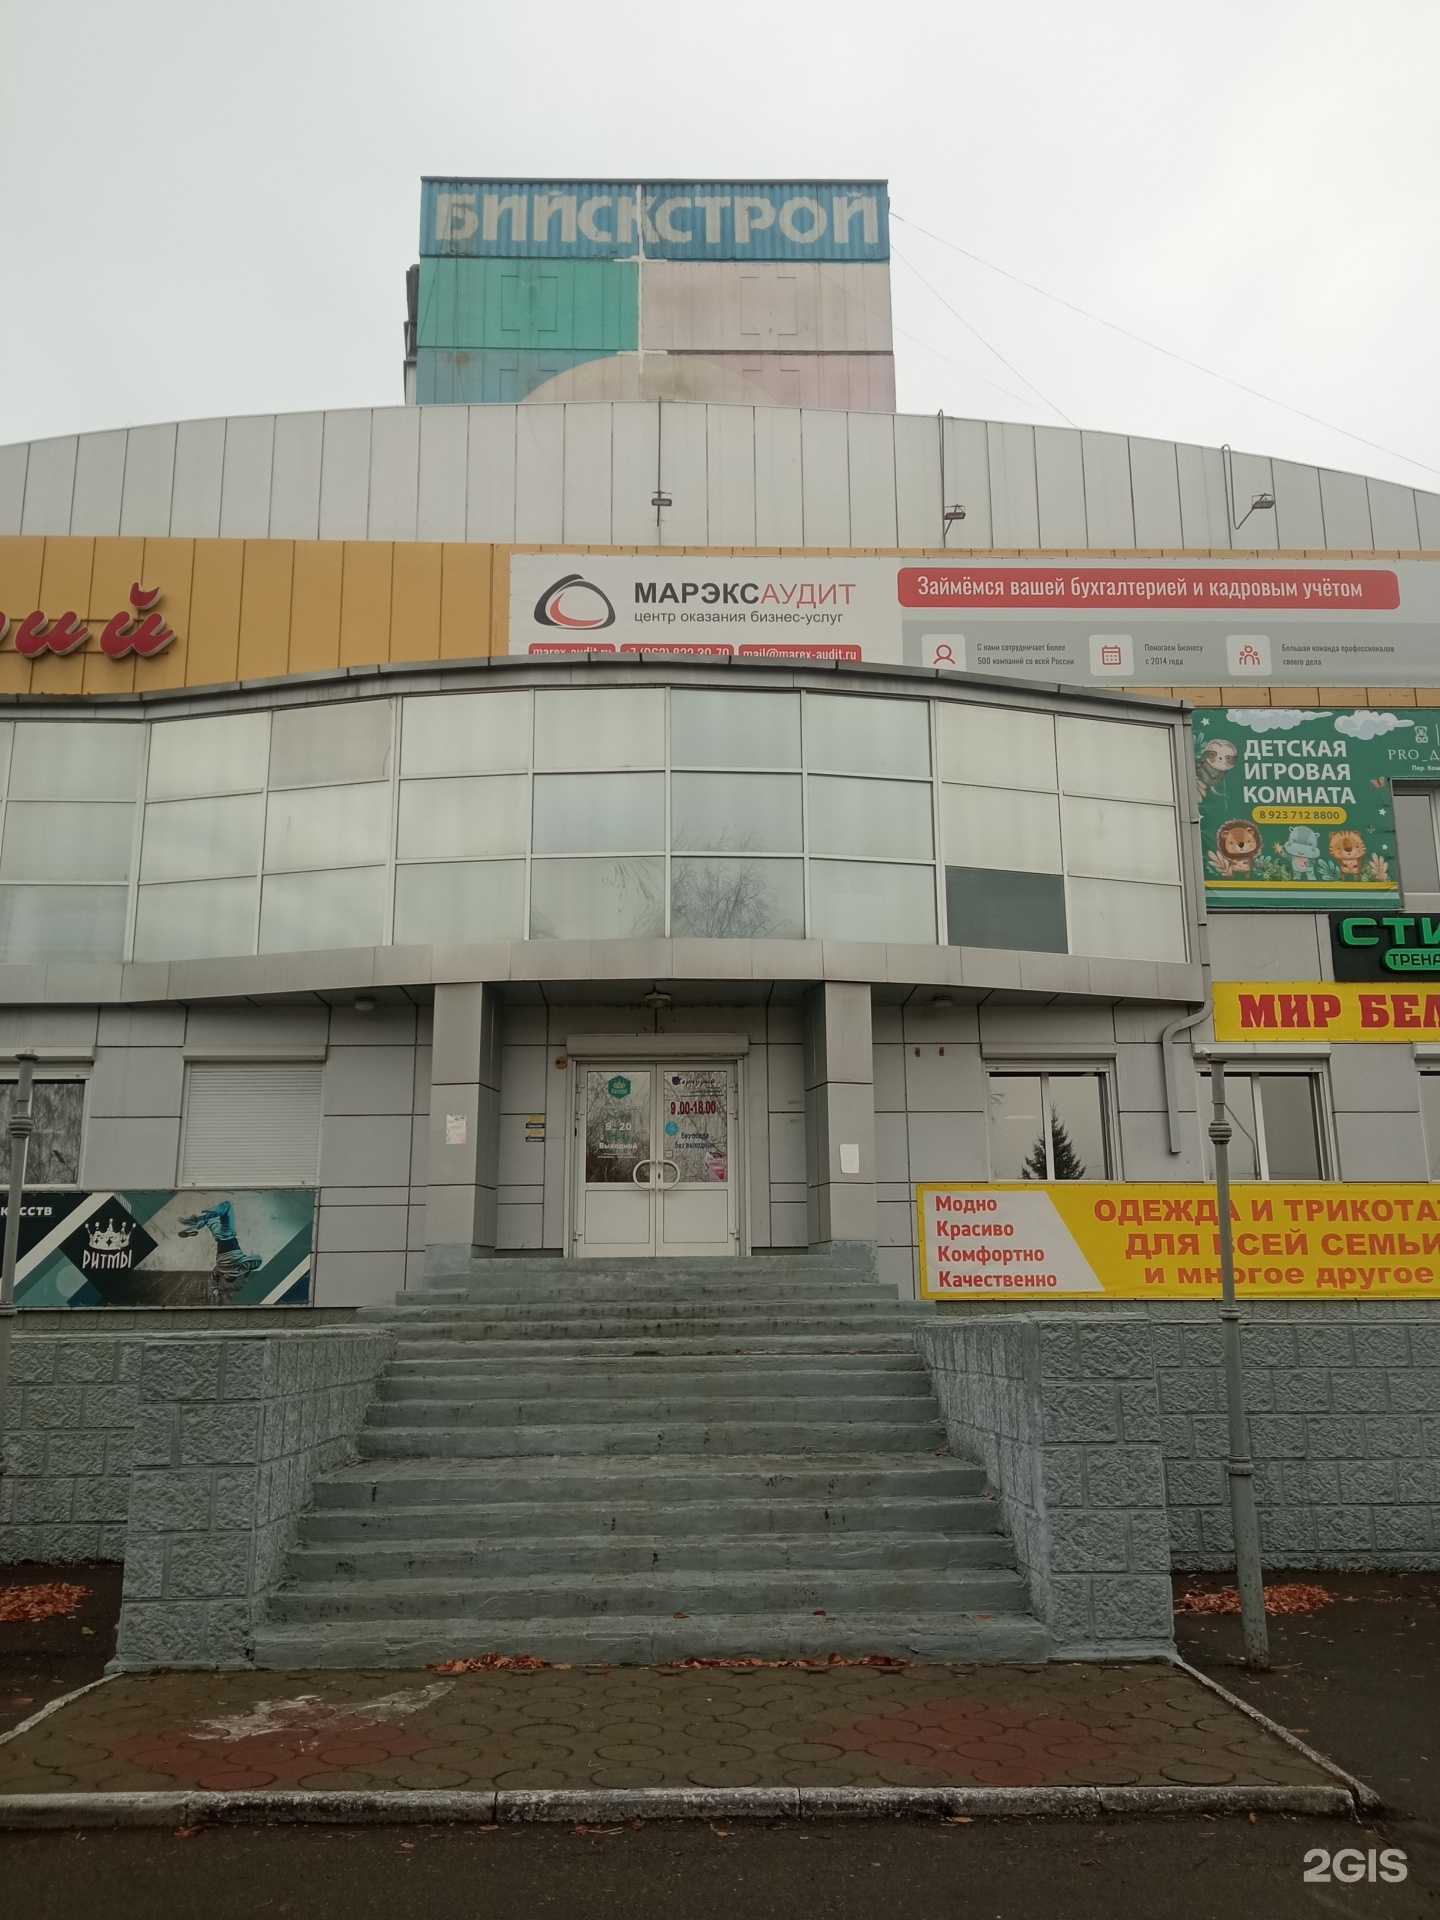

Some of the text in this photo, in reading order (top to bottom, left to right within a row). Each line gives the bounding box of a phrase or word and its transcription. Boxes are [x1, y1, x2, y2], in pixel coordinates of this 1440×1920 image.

[434, 190, 879, 245] БИЙСКСТРОЙ
[634, 582, 856, 608] МАРЭКСАУДИТ
[917, 576, 1362, 600] Займёмся вашей бухгалтерией и кадровым учётом
[634, 610, 843, 625] центр оказания бизнес-услуг
[1144, 643, 1175, 652] Помогаем
[1312, 645, 1340, 653] команда
[977, 657, 991, 665] 500
[1035, 657, 1050, 665] всей
[1051, 657, 1075, 665] России
[1151, 657, 1167, 665] 2014
[1168, 658, 1184, 666] года
[1244, 739, 1347, 760] ДЕТСКАЯ
[1244, 763, 1351, 780] ИГРОВАЯ
[1243, 785, 1356, 804] КОМНАТА
[1259, 810, 1340, 820] 8 923 712 8800
[1238, 994, 1342, 1028] МИР
[0, 1206, 52, 1216] КССТВ
[936, 1196, 998, 1214] Модно
[1251, 1199, 1274, 1222] И
[1284, 1199, 1440, 1222] ТРИКОТА
[936, 1220, 1014, 1240] Красиво
[937, 1245, 1045, 1266] Комфортно
[1125, 1233, 1200, 1259] ДЛЯ
[1321, 1233, 1440, 1256] СЕМЬИ
[82, 1249, 132, 1269] РИТМЫ
[938, 1270, 1057, 1287] Качественно
[1144, 1266, 1434, 1290] и многое другое
